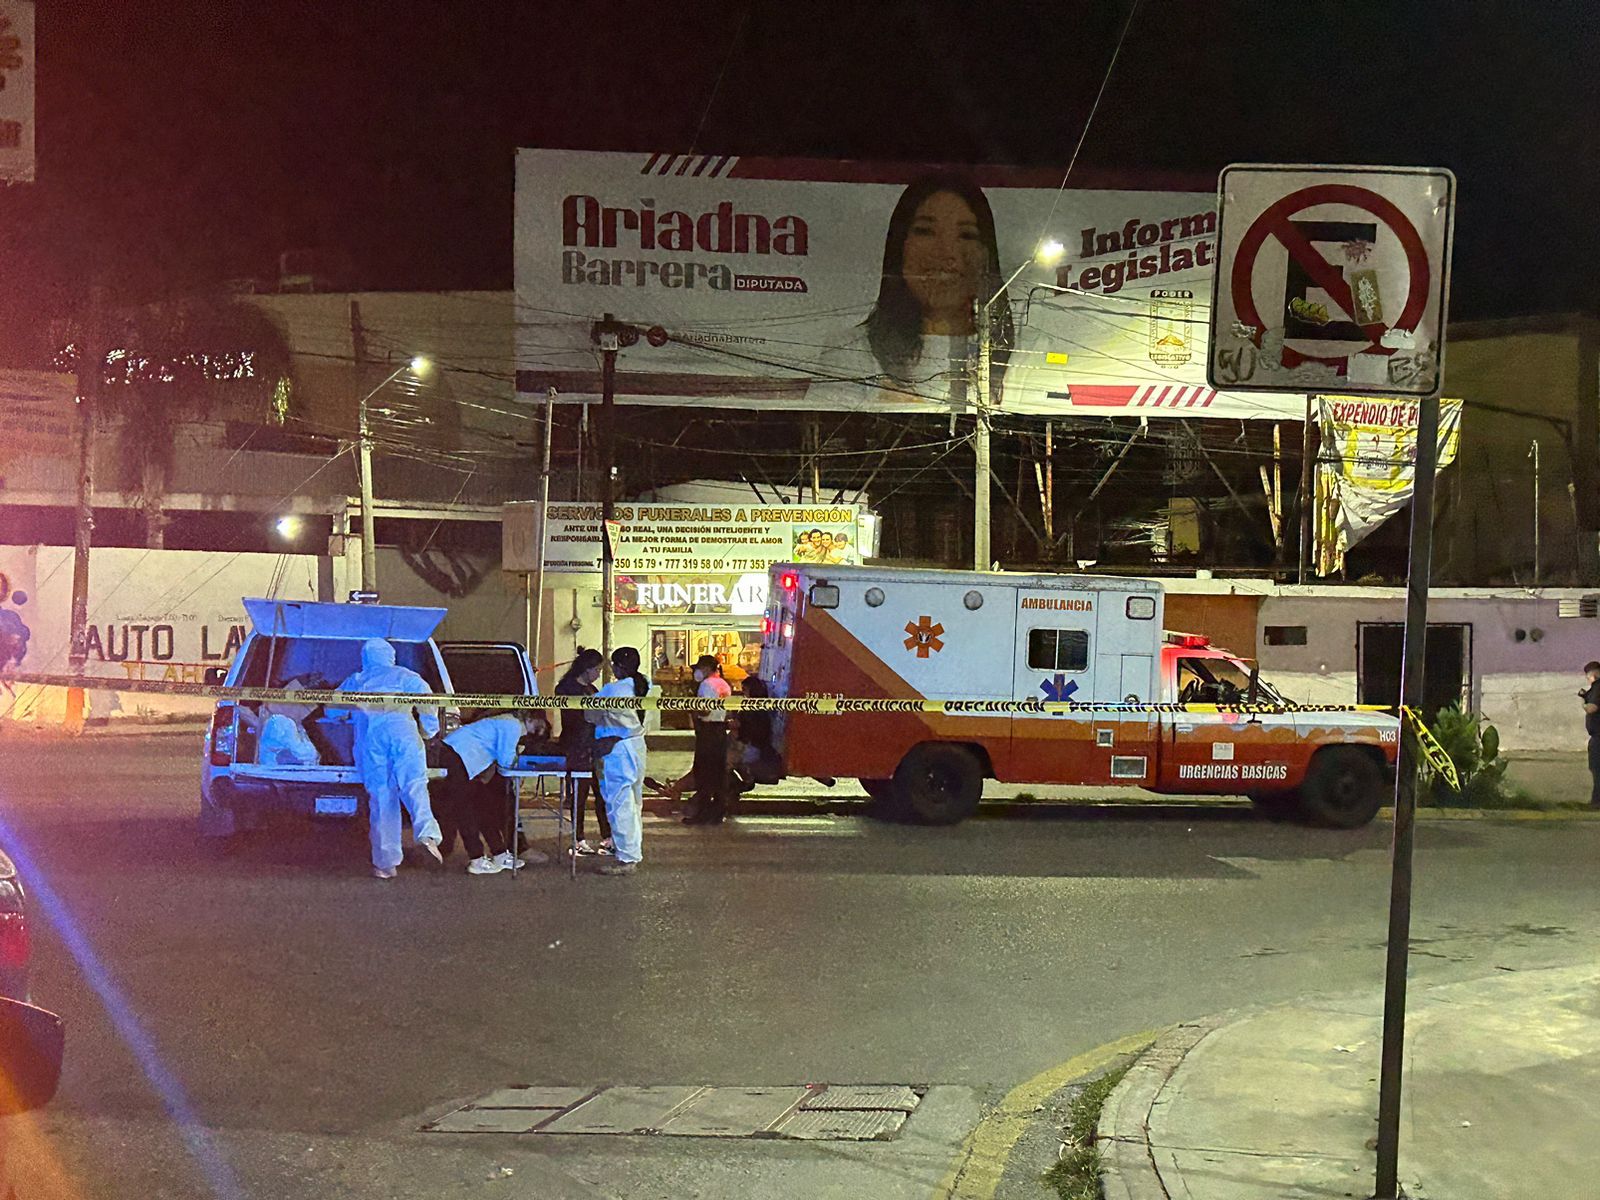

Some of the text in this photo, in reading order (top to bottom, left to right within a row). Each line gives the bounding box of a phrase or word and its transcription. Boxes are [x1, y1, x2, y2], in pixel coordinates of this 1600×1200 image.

[562, 195, 808, 256] Ariadna
[562, 250, 803, 291] Barrera DIPUTADA
[1053, 240, 1216, 297] Legislat
[1154, 290, 1190, 298] PODER
[1333, 402, 1388, 425] EXPENDIO
[1391, 402, 1406, 427] DE
[638, 507, 731, 522] FUNERALES
[735, 508, 747, 522] A
[750, 507, 852, 523] PREVENCIÓN
[633, 526, 655, 534] REAL,
[675, 525, 711, 534] DECISIÓN
[700, 536, 748, 544] DEMOSTRAR
[615, 558, 630, 568] 350
[634, 558, 644, 568] 15
[645, 558, 656, 569] 79
[665, 558, 681, 569] 777
[683, 559, 699, 569] 319
[701, 559, 710, 569] 58
[713, 559, 723, 569] 00
[732, 559, 748, 570] 777
[750, 560, 765, 570] 353
[1021, 598, 1093, 611] AMBULANCIA
[86, 624, 174, 661] AUTO
[450, 694, 500, 707] PRECAUCION
[512, 696, 568, 708] PRECAUCION
[580, 697, 642, 709] PRECAUCION
[656, 698, 726, 711] PRECAUCION
[740, 699, 818, 711] PRECAUCION
[836, 700, 924, 712] PRECAUCION
[944, 701, 1046, 712] PRECAUCION
[1379, 730, 1397, 743] H03
[1180, 764, 1287, 780] URGENCIAS BASICAS
